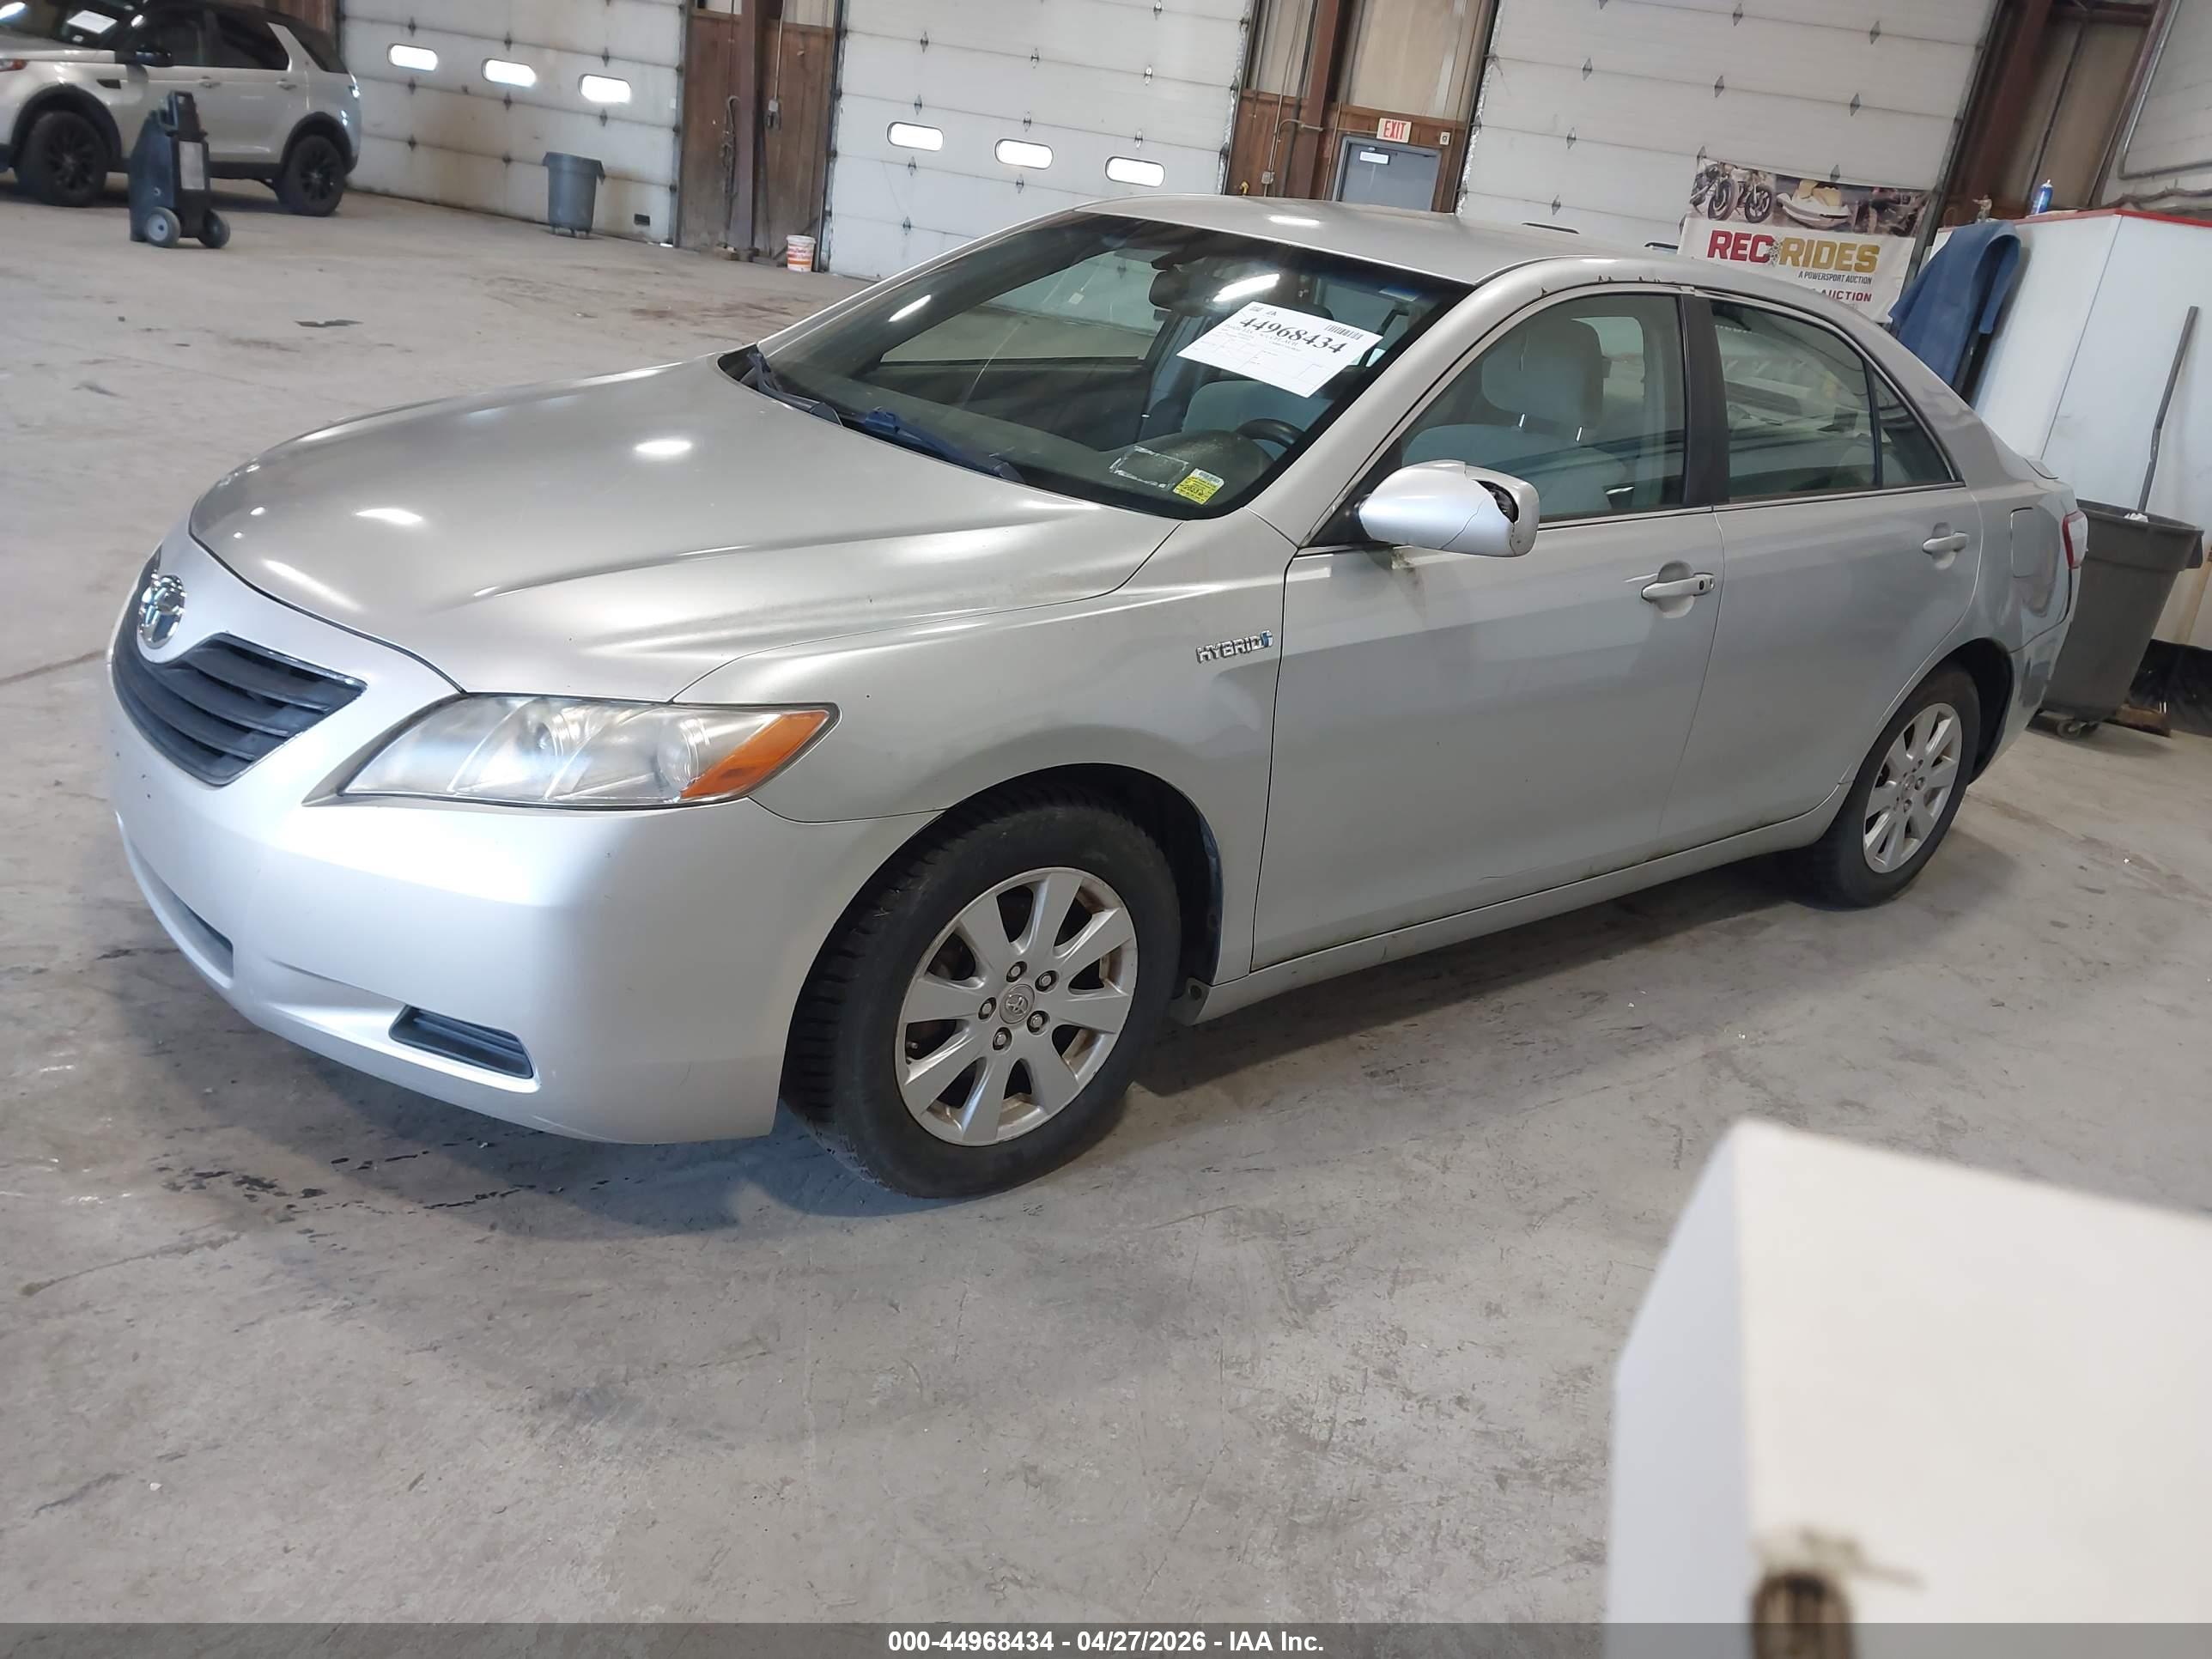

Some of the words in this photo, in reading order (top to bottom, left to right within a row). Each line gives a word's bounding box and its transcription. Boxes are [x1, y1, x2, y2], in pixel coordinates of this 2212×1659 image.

[1383, 120, 1407, 140] EXIT
[1707, 229, 1776, 264] REC
[1778, 237, 1881, 273] RIDES
[1804, 271, 1845, 283] POWERSPORT
[1845, 275, 1872, 285] AUCTION
[1239, 318, 1348, 354] 44968434
[1196, 635, 1262, 664] HYBRID
